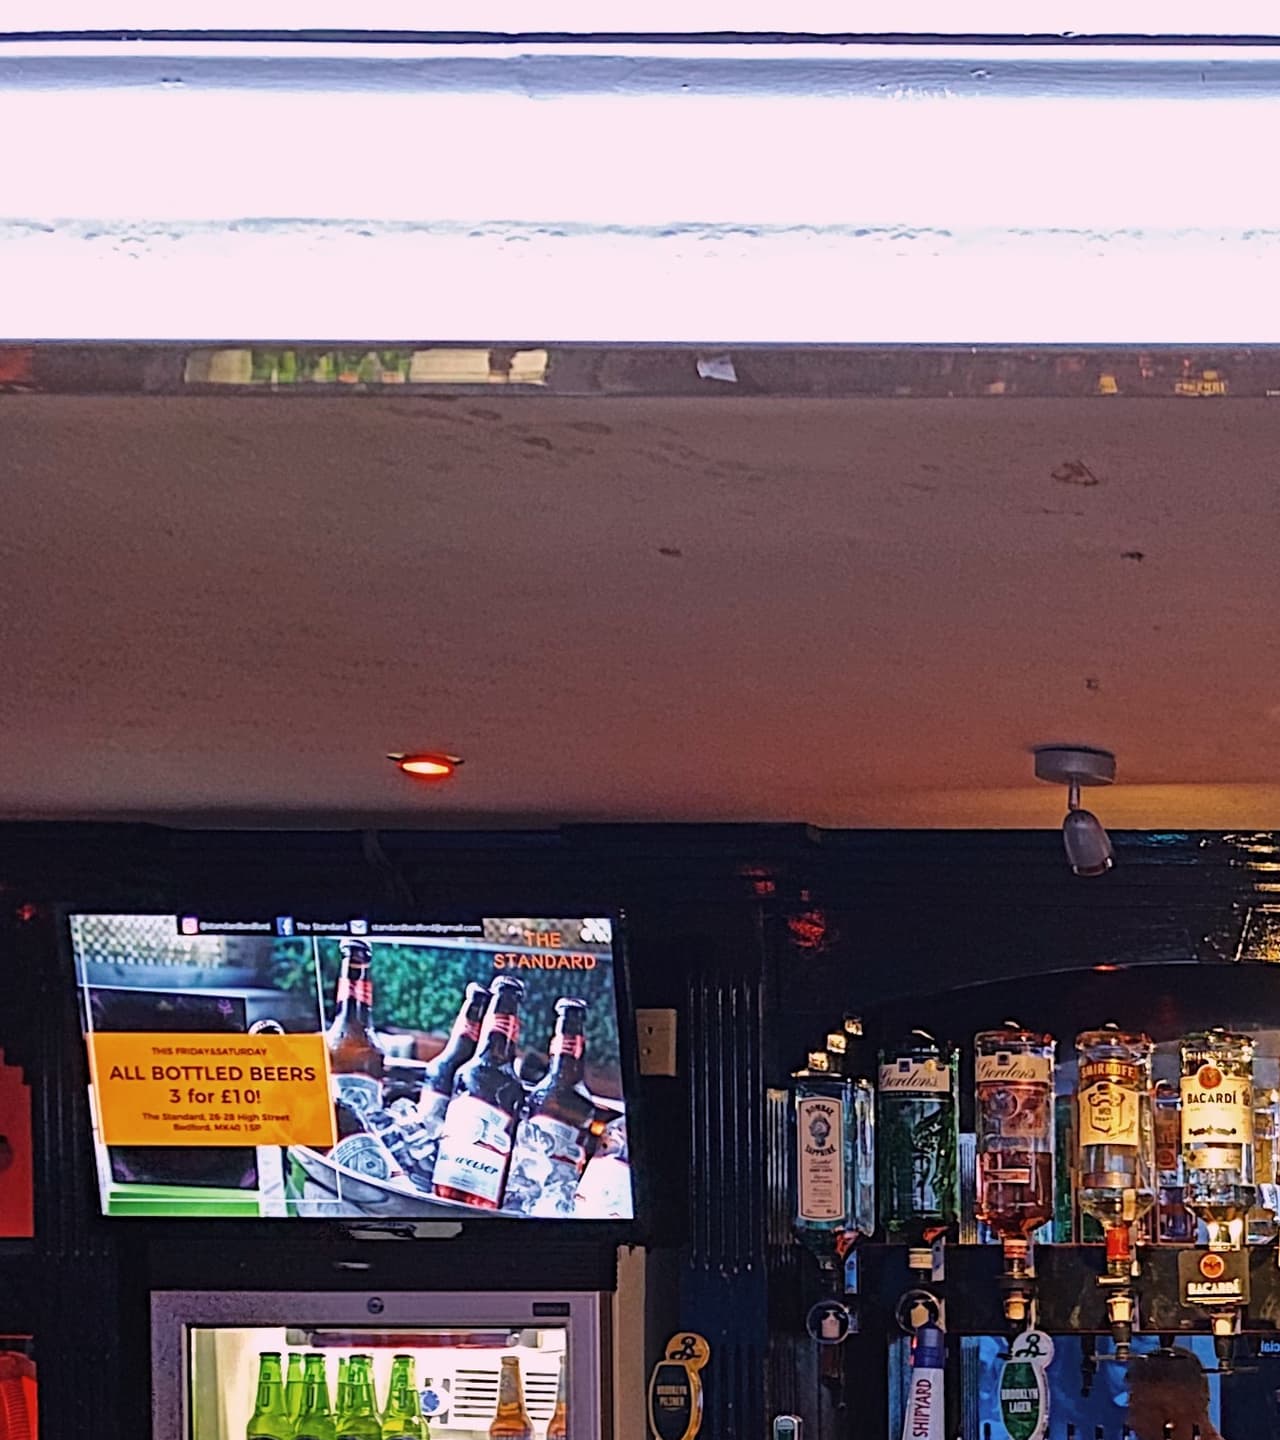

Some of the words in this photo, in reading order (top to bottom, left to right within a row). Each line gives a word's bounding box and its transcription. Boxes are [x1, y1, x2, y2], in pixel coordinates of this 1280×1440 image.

[524, 931, 562, 948] THE
[493, 953, 597, 970] STANDARD
[151, 1047, 173, 1056] THIS
[109, 1065, 146, 1081] ALL
[151, 1065, 244, 1082] BOTTLED
[249, 1066, 317, 1082] BEERS
[977, 1058, 1036, 1080] Gordon's
[879, 1071, 938, 1088] Gordon's
[168, 1088, 182, 1105] 3
[187, 1087, 215, 1105] for
[221, 1088, 261, 1105] £10!
[1187, 1091, 1237, 1105] BACARDÍ
[142, 1112, 160, 1121] The
[261, 1113, 290, 1122] Street
[1001, 1387, 1039, 1401] BROOKLYN
[912, 1378, 932, 1439] SHIPYARD
[1008, 1401, 1032, 1414] LAGER
